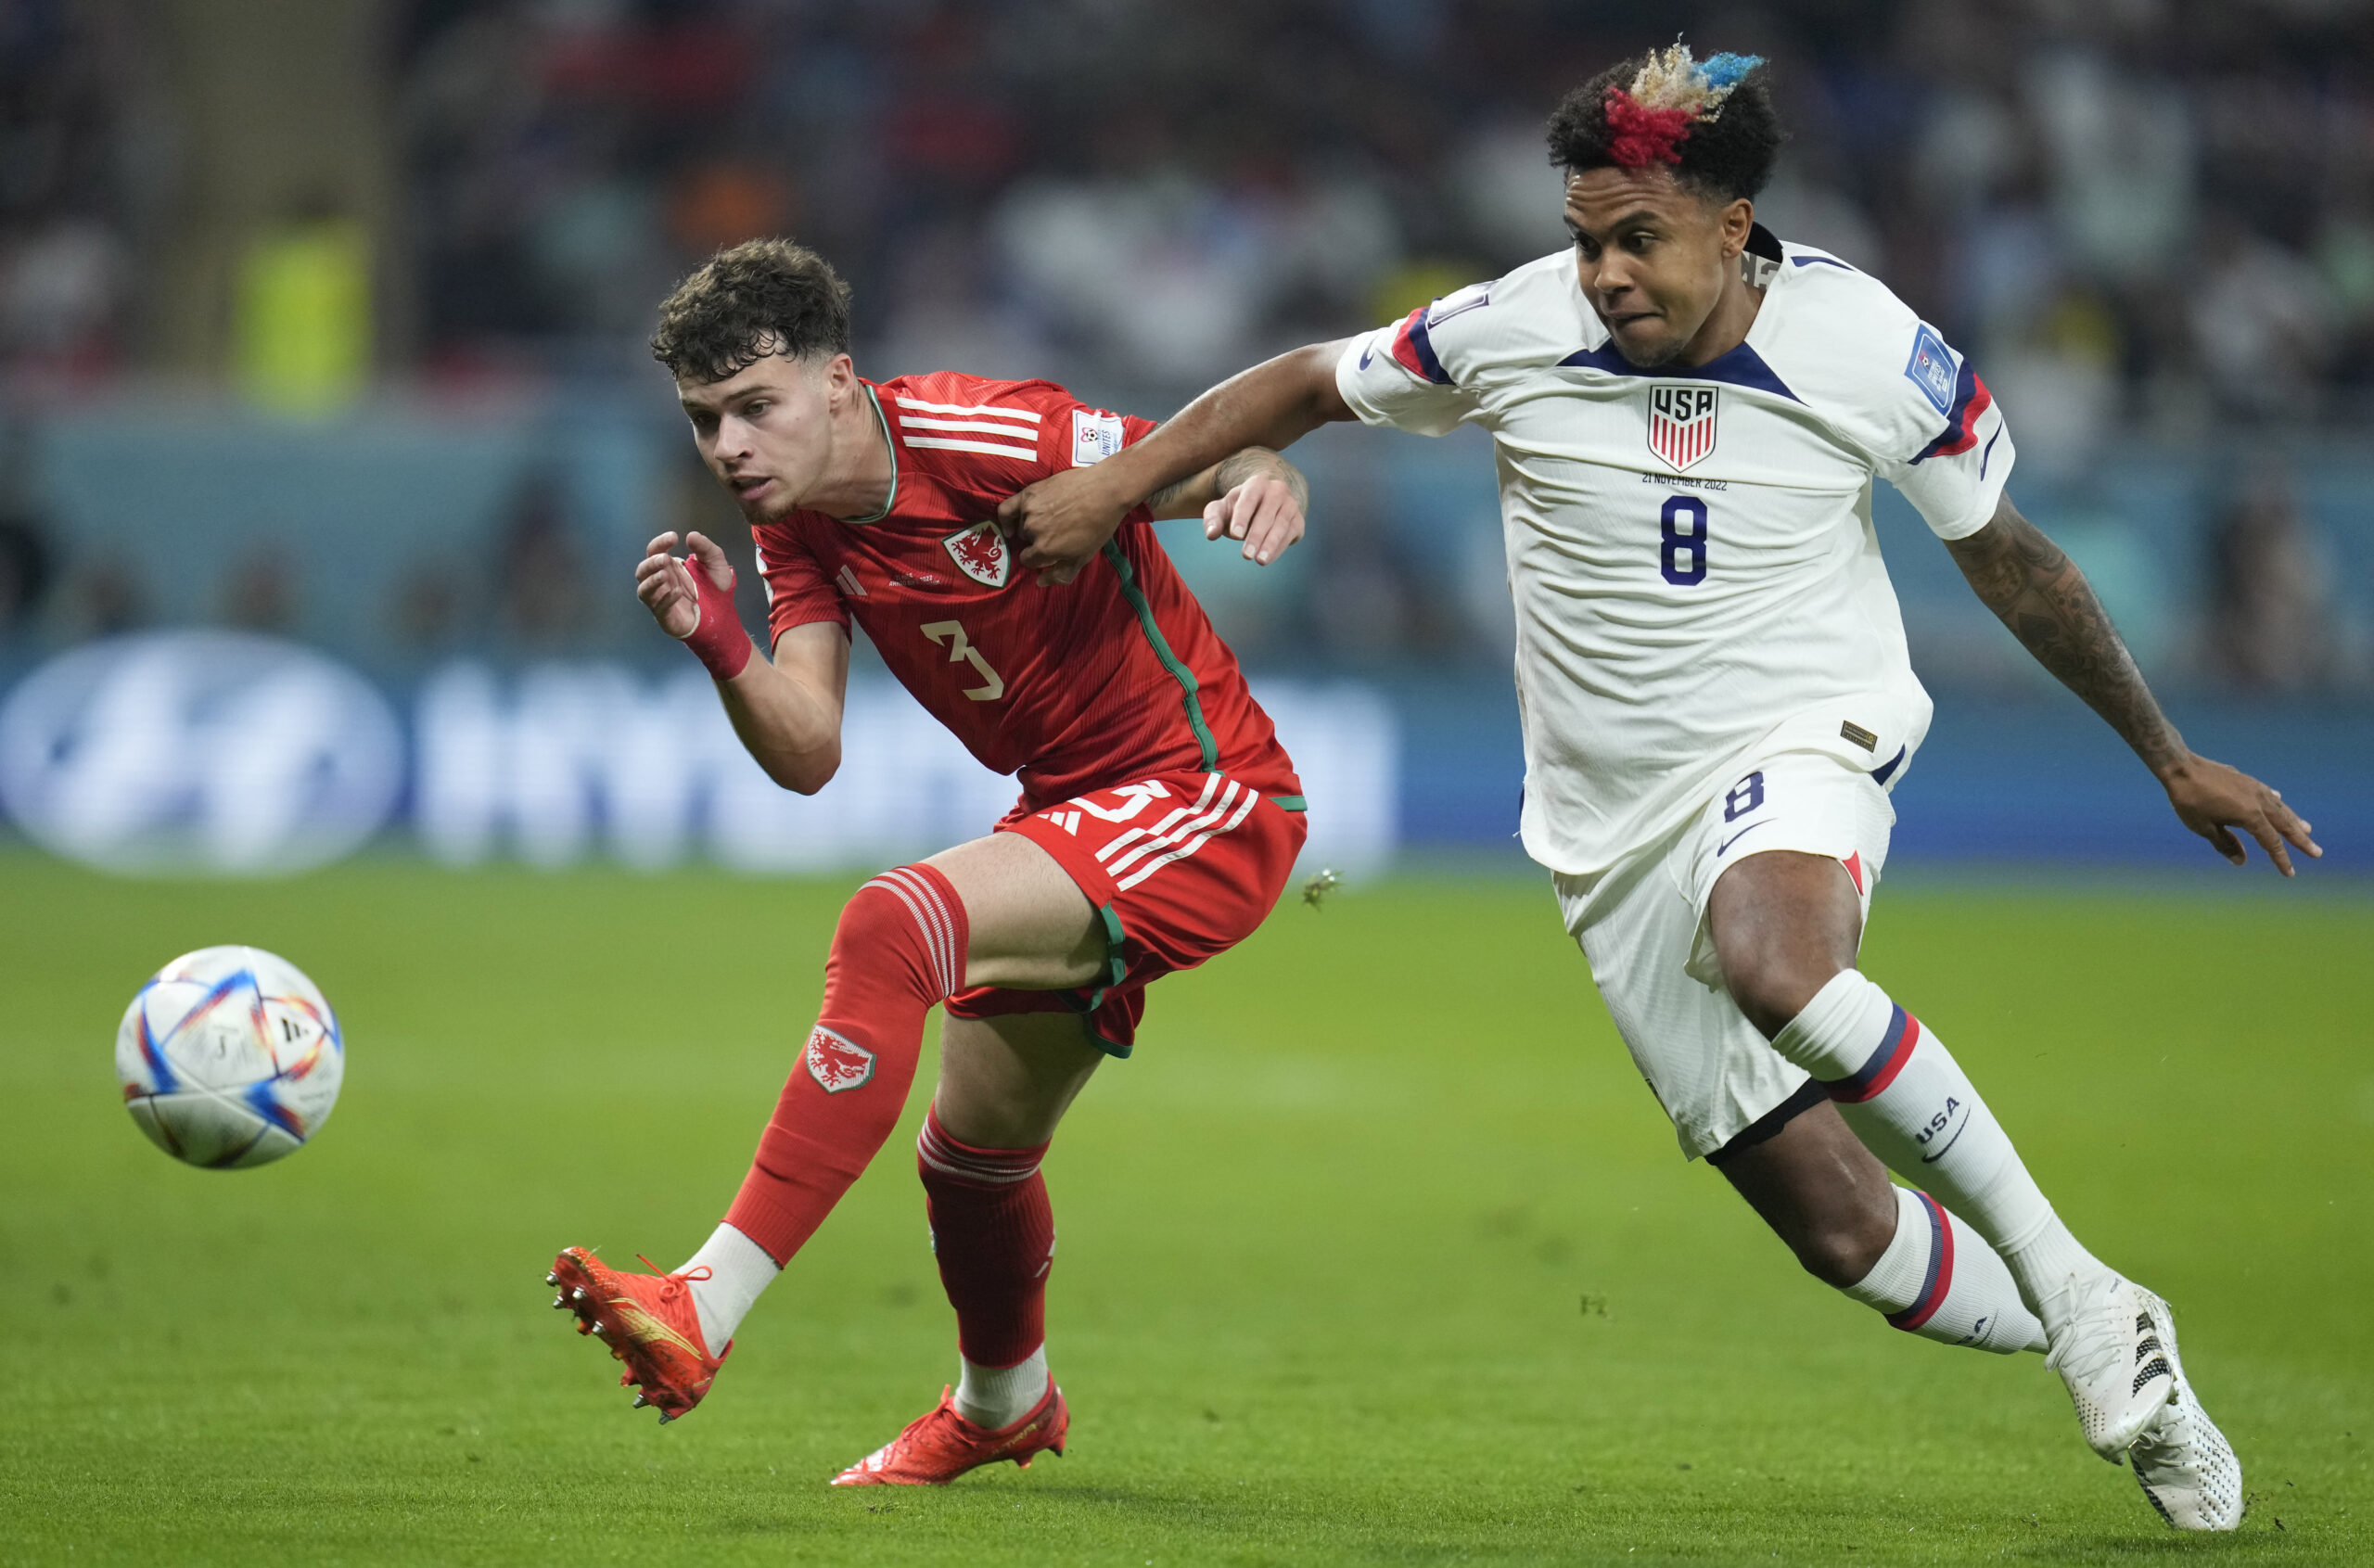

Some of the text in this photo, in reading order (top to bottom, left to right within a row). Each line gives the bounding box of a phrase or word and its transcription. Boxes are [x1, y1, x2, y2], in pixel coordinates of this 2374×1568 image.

[1654, 389, 1714, 422] USA
[1101, 429, 1112, 456] UNITES
[1641, 472, 1728, 491] 21 NOVEMBER 2022
[1660, 495, 1708, 586] 8
[920, 619, 1004, 701] 3
[1066, 779, 1172, 823] 3
[1723, 771, 1765, 823] 8
[1915, 1096, 1960, 1144] USA
